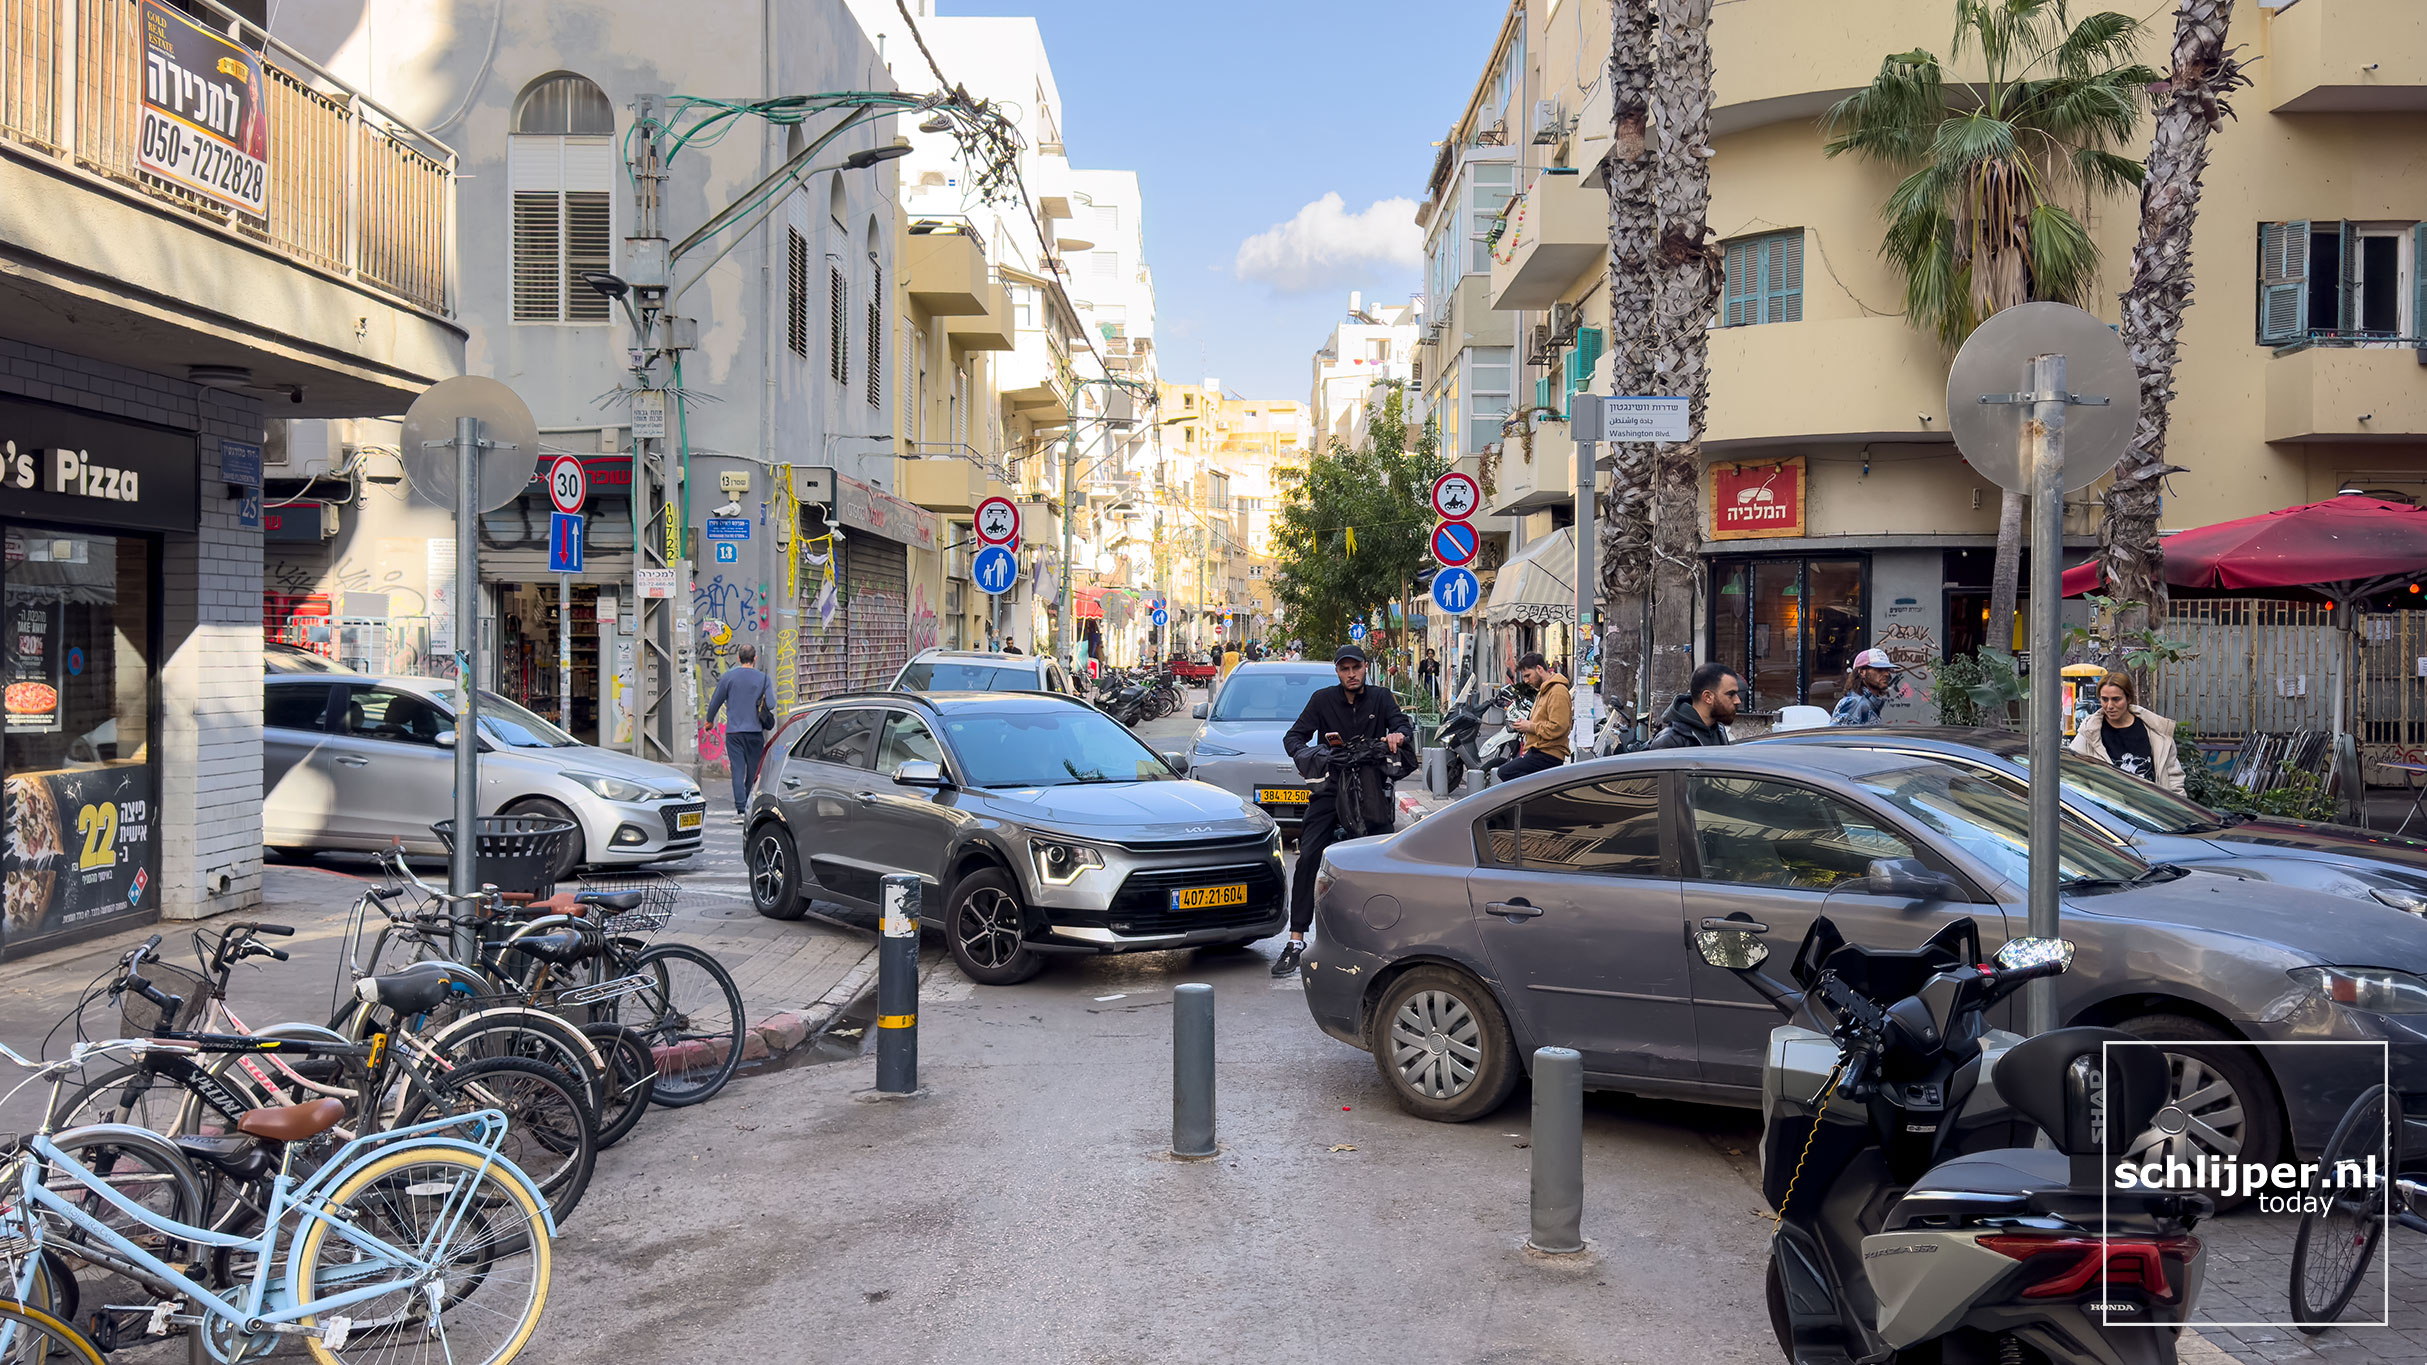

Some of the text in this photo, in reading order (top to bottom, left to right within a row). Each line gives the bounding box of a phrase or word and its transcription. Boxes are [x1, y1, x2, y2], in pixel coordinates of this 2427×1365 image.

[147, 10, 167, 29] GOLD
[148, 21, 166, 39] REAL
[148, 51, 239, 138] למכירה
[143, 114, 263, 203] 050-7272828
[1609, 403, 1650, 412] וושינגטון
[1609, 430, 1654, 438] Washington
[57, 448, 138, 502] Pizza
[721, 476, 730, 486] 13
[558, 473, 577, 497] 30
[242, 496, 257, 518] 25
[1727, 503, 1786, 521] המלביה
[720, 546, 732, 559] 13
[639, 569, 674, 578] למכירה
[18, 621, 47, 634] TAKE AWAY
[120, 800, 146, 823] פיצה
[78, 801, 118, 872] 22
[119, 824, 147, 843] אישית
[2089, 1069, 2104, 1144] SHAD
[62, 1205, 116, 1243] Mojo Retro
[2090, 1303, 2134, 1311] HONDA
